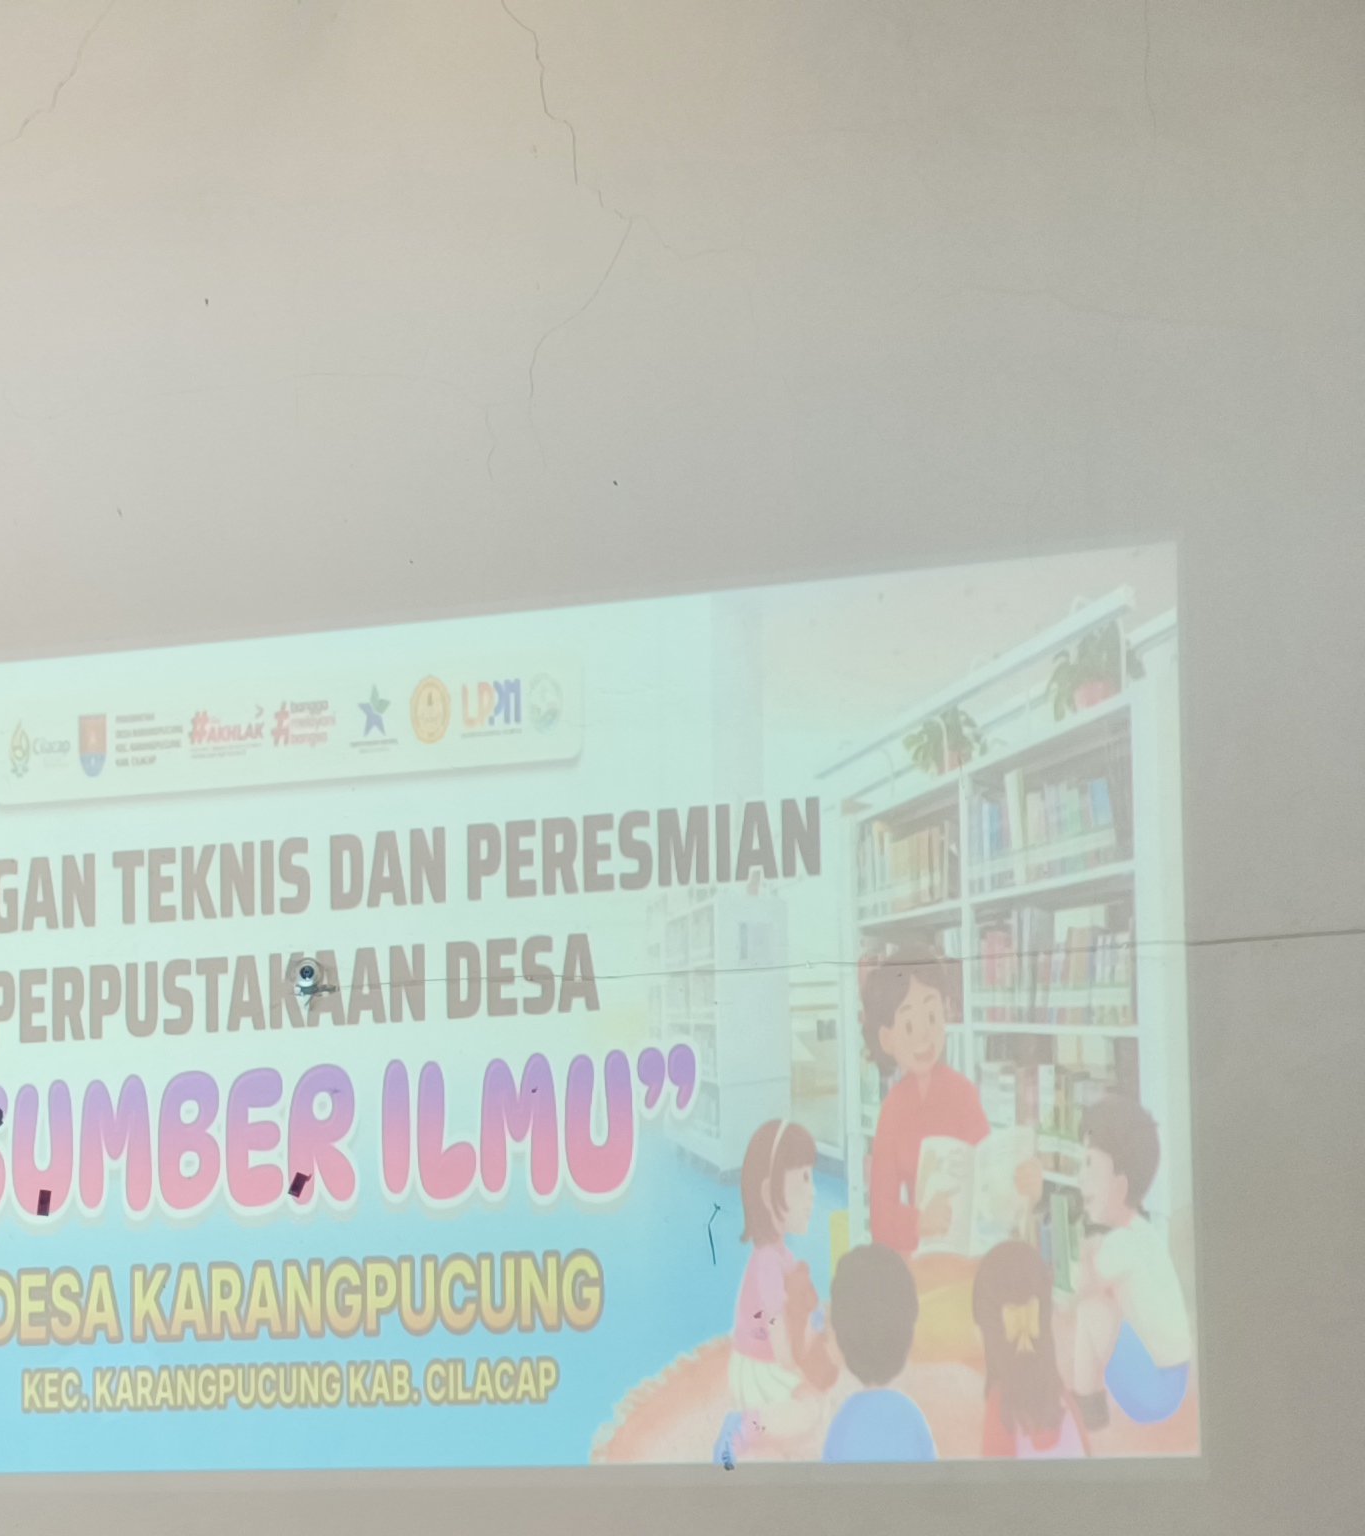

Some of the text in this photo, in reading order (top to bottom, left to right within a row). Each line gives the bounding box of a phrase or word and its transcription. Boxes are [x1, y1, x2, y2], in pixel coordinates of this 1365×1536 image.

[112, 836, 313, 926] TEKNIS
[328, 824, 448, 913] DAN
[466, 797, 823, 905] PERESMIAN
[444, 933, 601, 1020] DESA
[131, 1249, 605, 1344] KARANGPUCUNG
[22, 1356, 558, 1413] KEC. KARANGPUCUNG KAB. CILACAP
